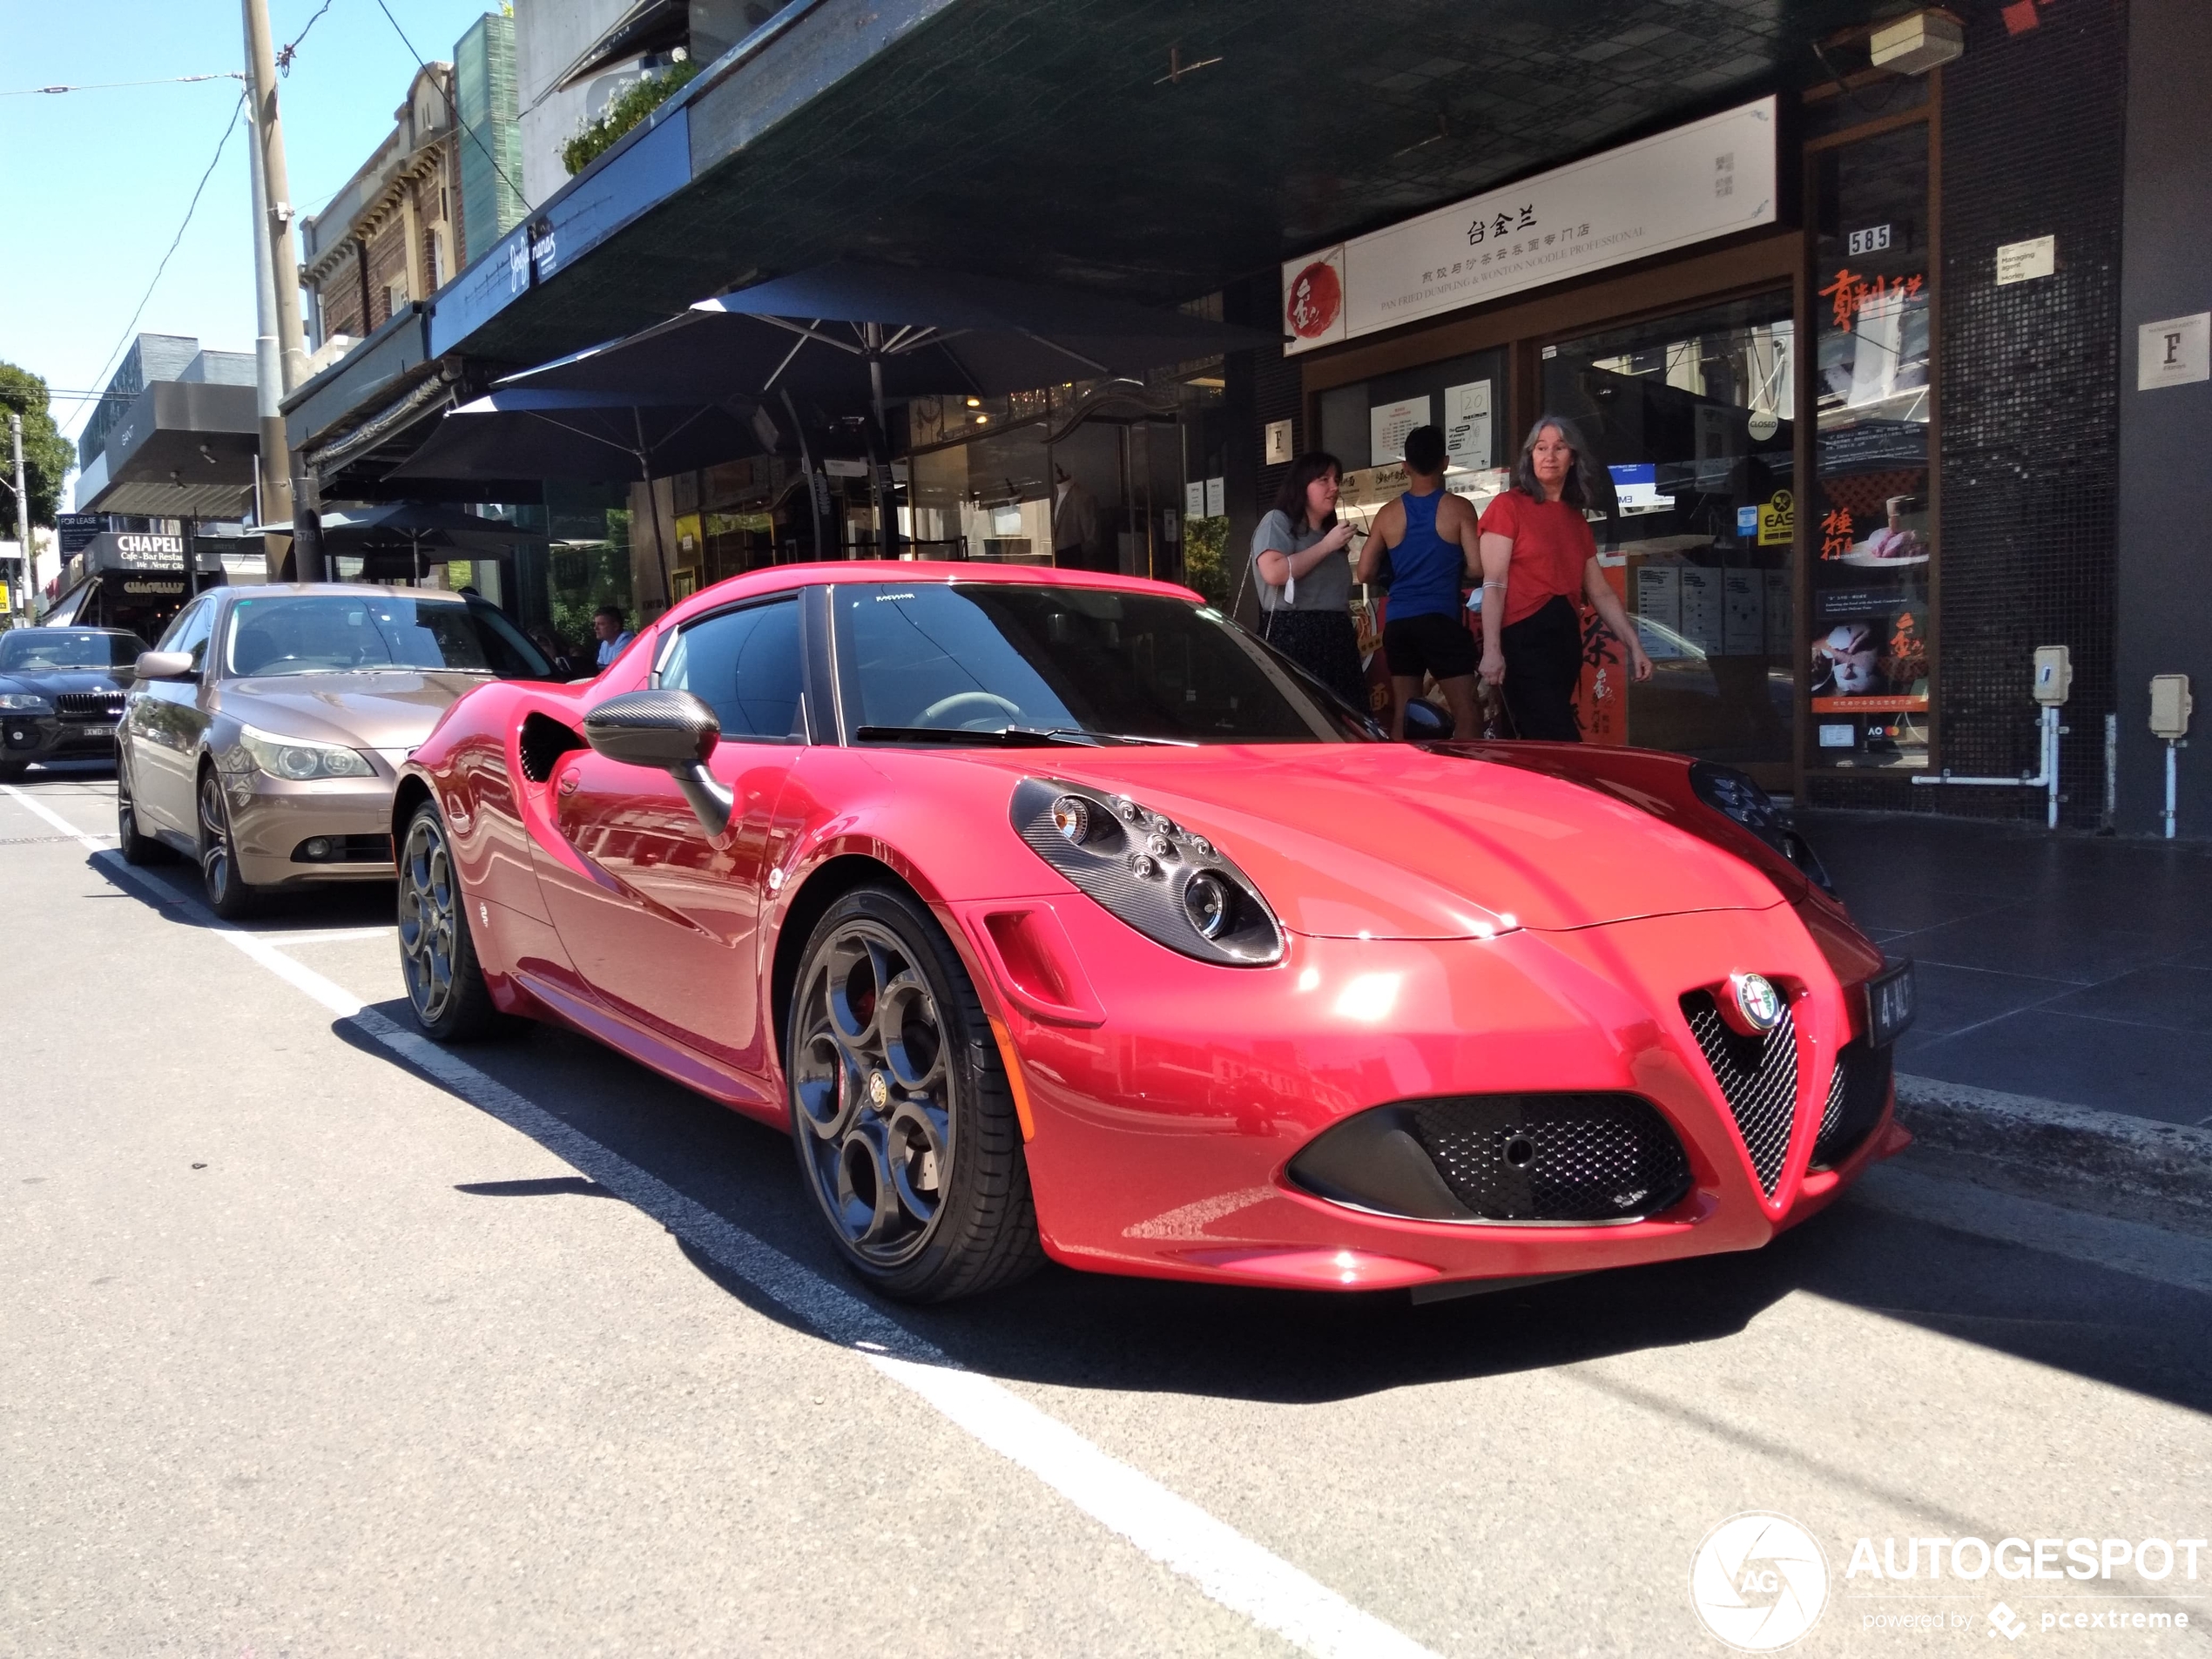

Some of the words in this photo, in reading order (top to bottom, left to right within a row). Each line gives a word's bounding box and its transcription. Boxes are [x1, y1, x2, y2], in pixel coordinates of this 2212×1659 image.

[1852, 226, 1887, 253] 585
[2001, 252, 2035, 264] Managing
[1380, 300, 1397, 311] PAN
[1398, 291, 1423, 306] FRIED
[1425, 278, 1471, 299] DUMPLING
[1480, 262, 1523, 281] WONTON
[1526, 249, 1568, 267] NOODLE
[1569, 226, 1646, 256] PROFESSIONAL
[2163, 333, 2181, 364] F
[1464, 394, 1483, 411] 20
[1463, 411, 1487, 421] maximum
[121, 424, 134, 446] GANT
[1275, 430, 1282, 449] F
[297, 530, 315, 542] 579
[120, 552, 138, 561] Cafe
[1868, 726, 1883, 736] AO
